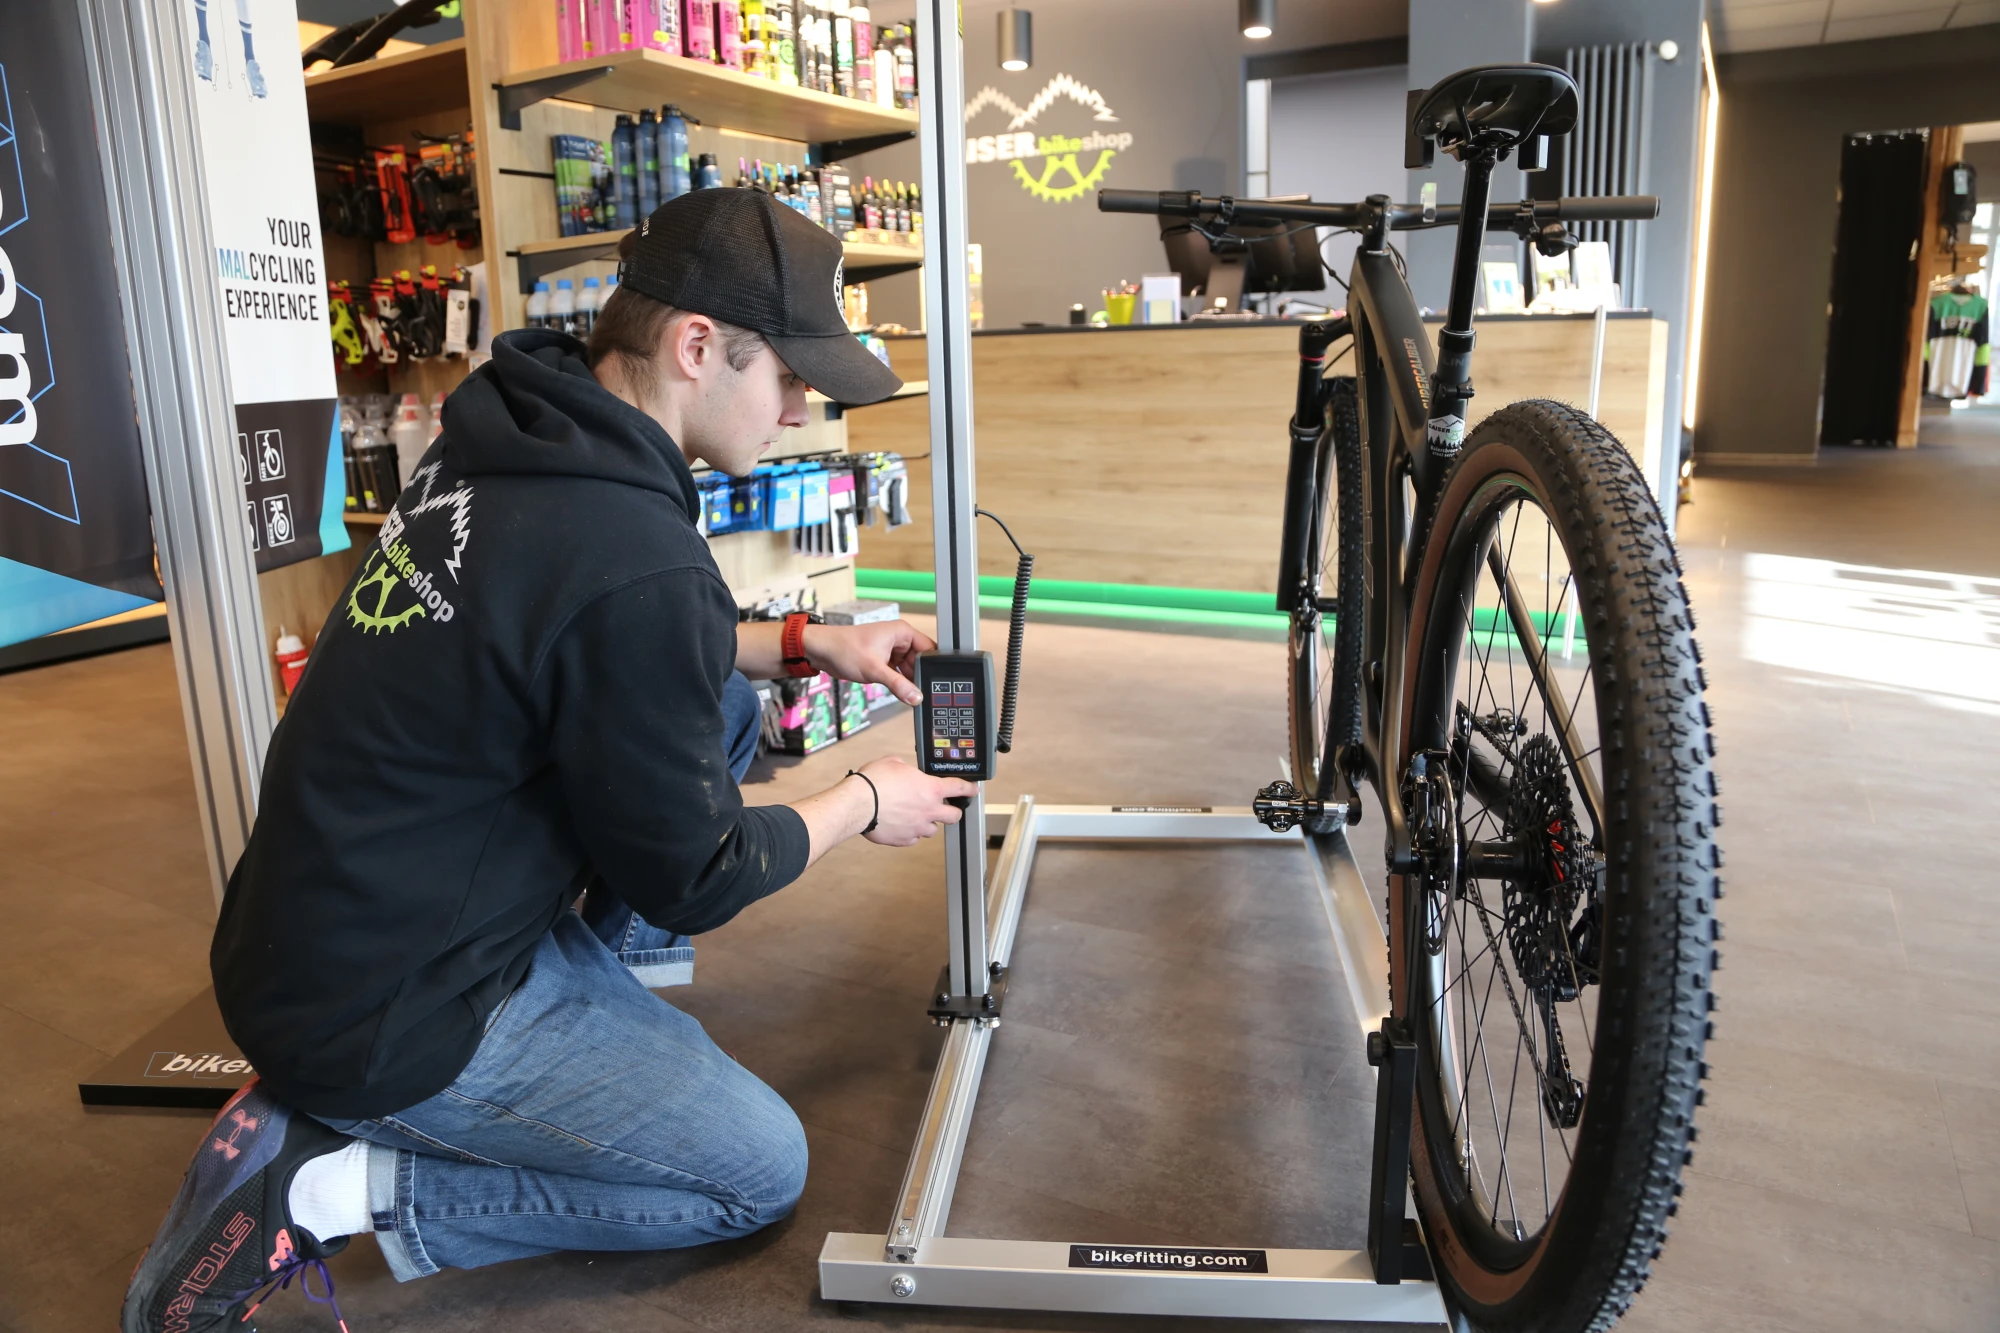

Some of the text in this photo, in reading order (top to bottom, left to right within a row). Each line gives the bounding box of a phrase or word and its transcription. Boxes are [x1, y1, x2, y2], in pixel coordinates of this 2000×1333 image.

[266, 217, 312, 249] YOUR
[225, 288, 319, 321] EXPERIENCE
[1091, 1250, 1248, 1267] bikefitting.com
